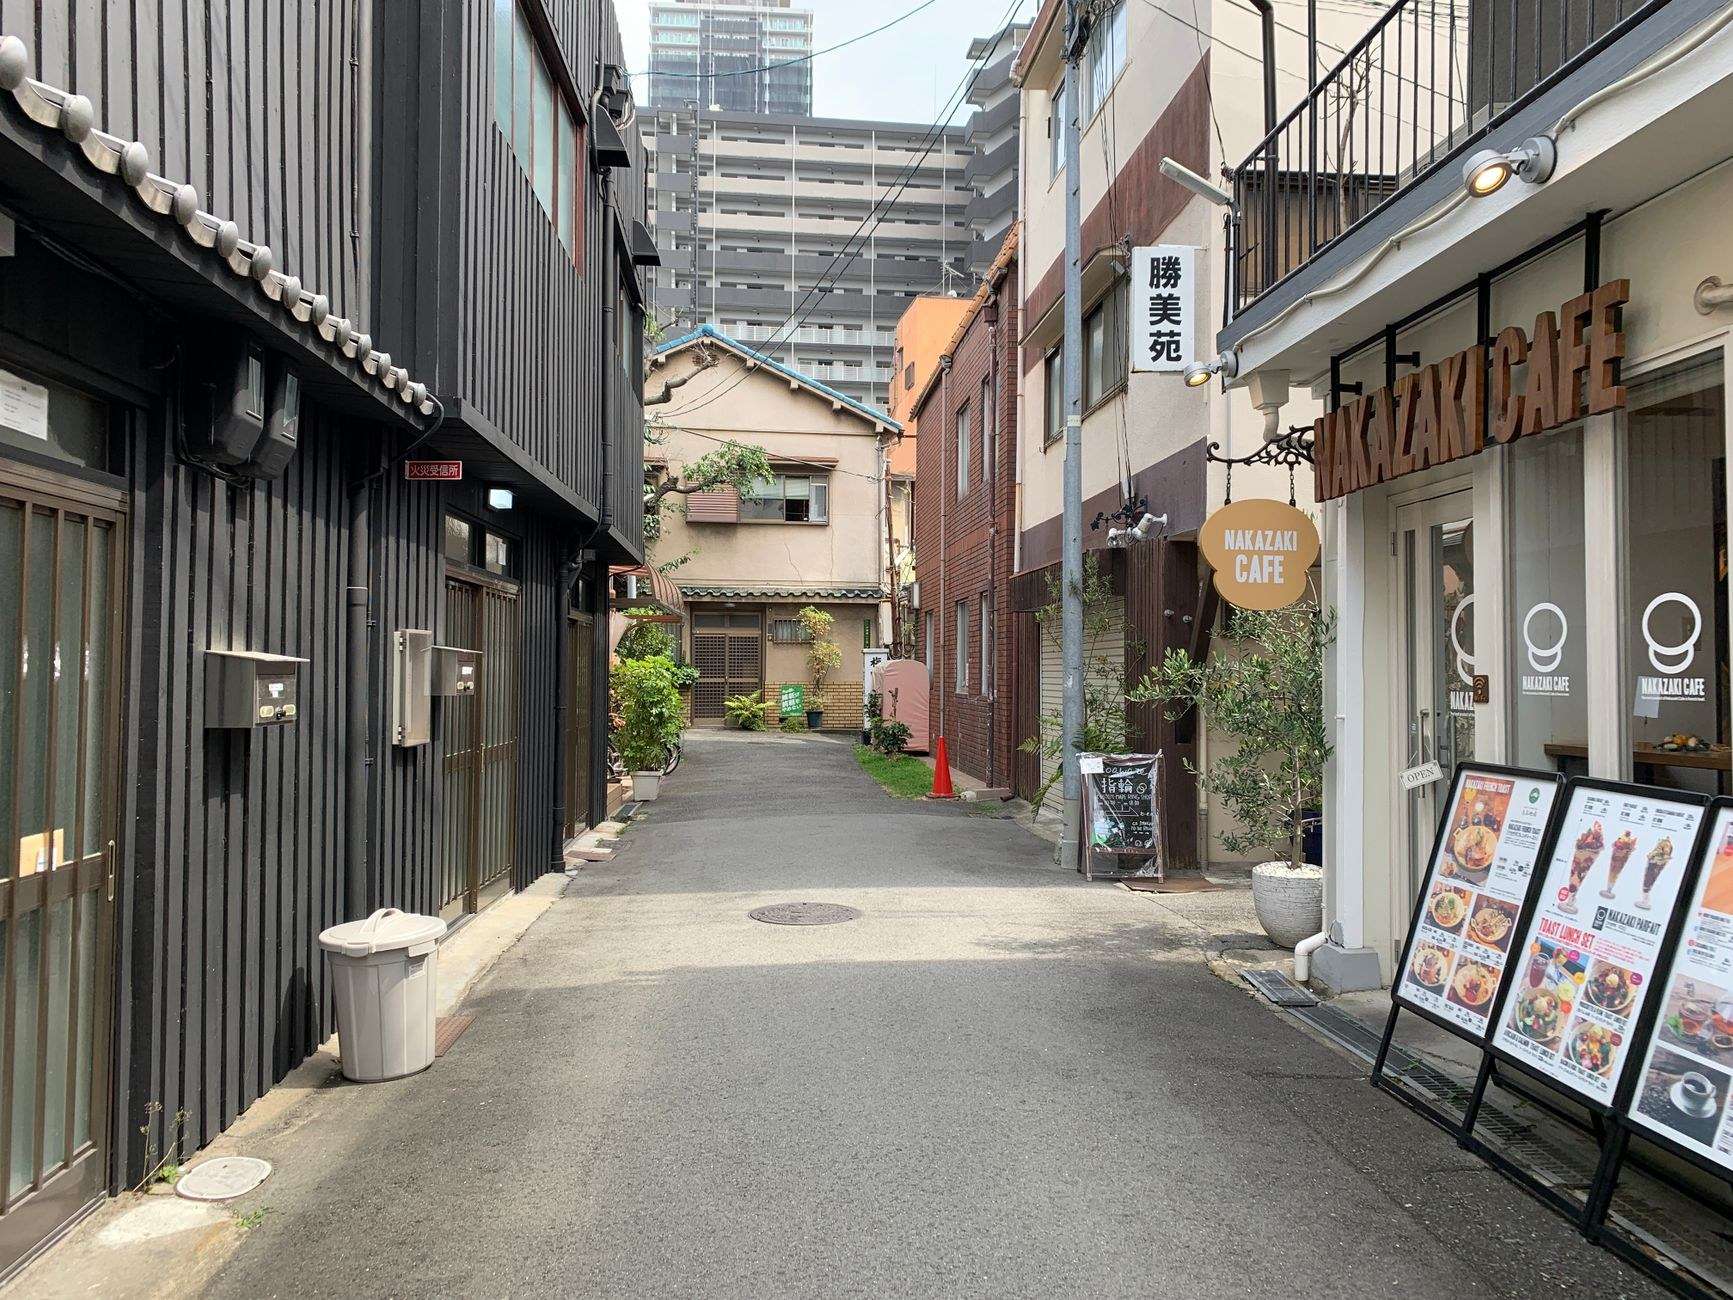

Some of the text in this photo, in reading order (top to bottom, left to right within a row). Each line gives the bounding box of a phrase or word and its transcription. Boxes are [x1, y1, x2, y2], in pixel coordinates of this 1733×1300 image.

[1149, 256, 1182, 362] 勝美苑
[1314, 279, 1630, 503] NAKAZAKI CAFE
[410, 464, 459, 476] 火災受信所
[1224, 530, 1297, 551] NAKAZAKI
[1235, 554, 1285, 584] CAFE
[1522, 676, 1570, 692] NAKAZAKI CAFE
[1641, 677, 1706, 696] NAKAZAKI CAFE
[1450, 691, 1474, 710] NAKAZ
[1407, 767, 1435, 783] OPEN
[1101, 778, 1133, 794] 指輪
[1607, 909, 1637, 930] NAKAZAKI
[1538, 917, 1560, 936] TOAST
[1560, 924, 1582, 945] LUNCH
[1582, 933, 1596, 949] SET
